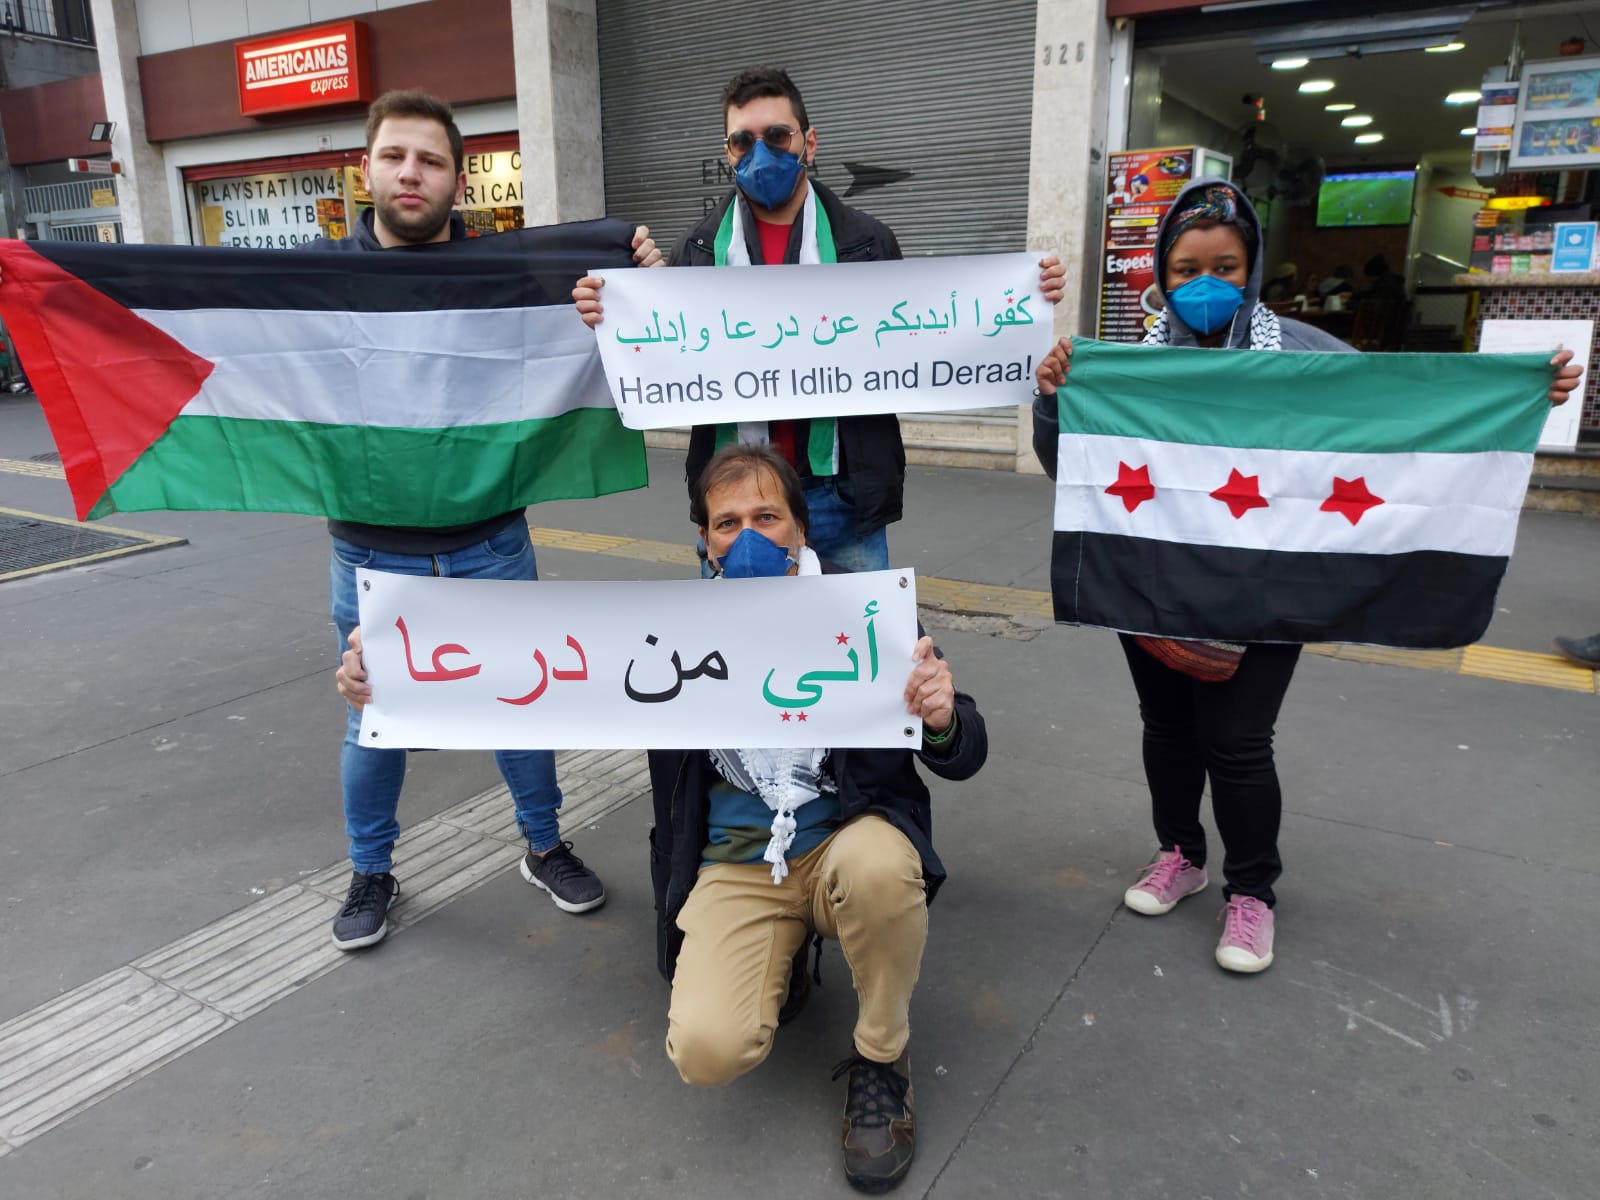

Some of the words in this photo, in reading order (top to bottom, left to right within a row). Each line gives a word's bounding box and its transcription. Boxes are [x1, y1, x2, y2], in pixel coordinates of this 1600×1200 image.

[246, 44, 348, 82] AMERICANAS
[1043, 41, 1085, 66] 326
[310, 75, 349, 95] express
[468, 154, 493, 174] EU
[201, 175, 336, 202] PLAYSTATION4
[464, 181, 523, 204] RICA
[225, 208, 270, 228] SLIM
[282, 205, 316, 225] 1TB
[1106, 252, 1154, 275] Especi
[616, 309, 710, 354] وإدلب
[721, 308, 799, 349] درعا
[813, 313, 859, 346] عن
[875, 290, 957, 348] أيديكم
[619, 373, 723, 404] Hands
[734, 369, 781, 399] Off
[791, 366, 852, 396] Idlib
[863, 361, 919, 391] and
[932, 355, 1032, 387] Deraa!
[395, 615, 588, 706] درعا
[624, 633, 729, 705] من
[762, 599, 879, 723] أني
